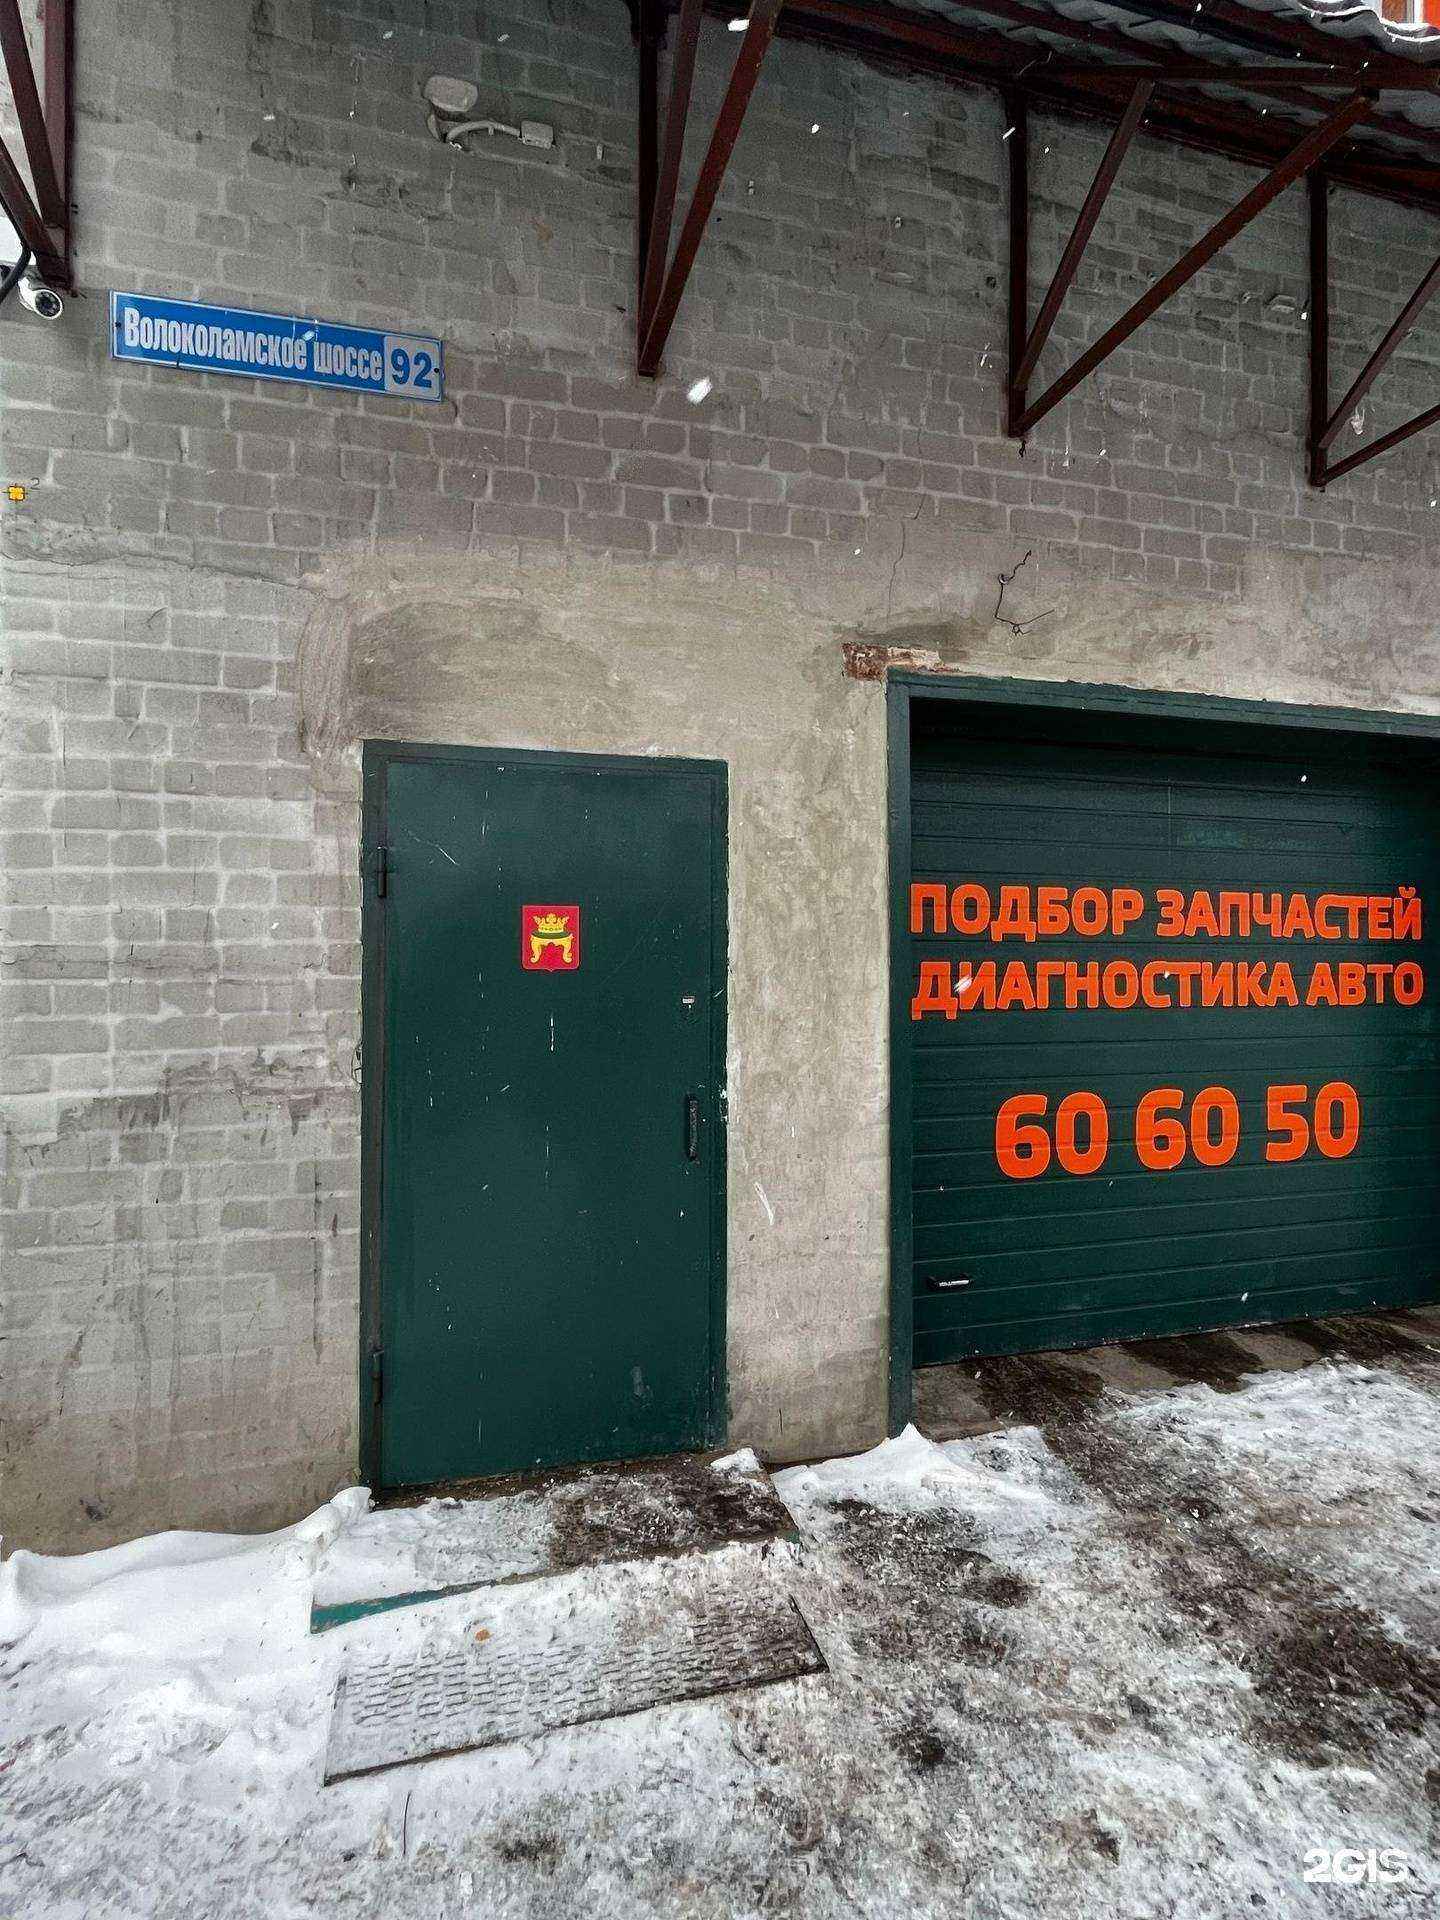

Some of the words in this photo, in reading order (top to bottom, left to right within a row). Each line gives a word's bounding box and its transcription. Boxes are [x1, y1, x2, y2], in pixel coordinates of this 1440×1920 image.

[124, 307, 307, 370] Волоколамское
[313, 341, 384, 381] шоссе
[391, 349, 432, 389] 92
[910, 883, 1143, 942] ПОДБОР
[1156, 887, 1422, 940] ЗАПЧАСТЕЙ
[911, 961, 1299, 1020] ДИАГНОСТИКА
[1306, 962, 1424, 1006] АВТО
[995, 1091, 1109, 1179] 60
[1136, 1086, 1240, 1170] 60
[1266, 1082, 1360, 1162] 50
